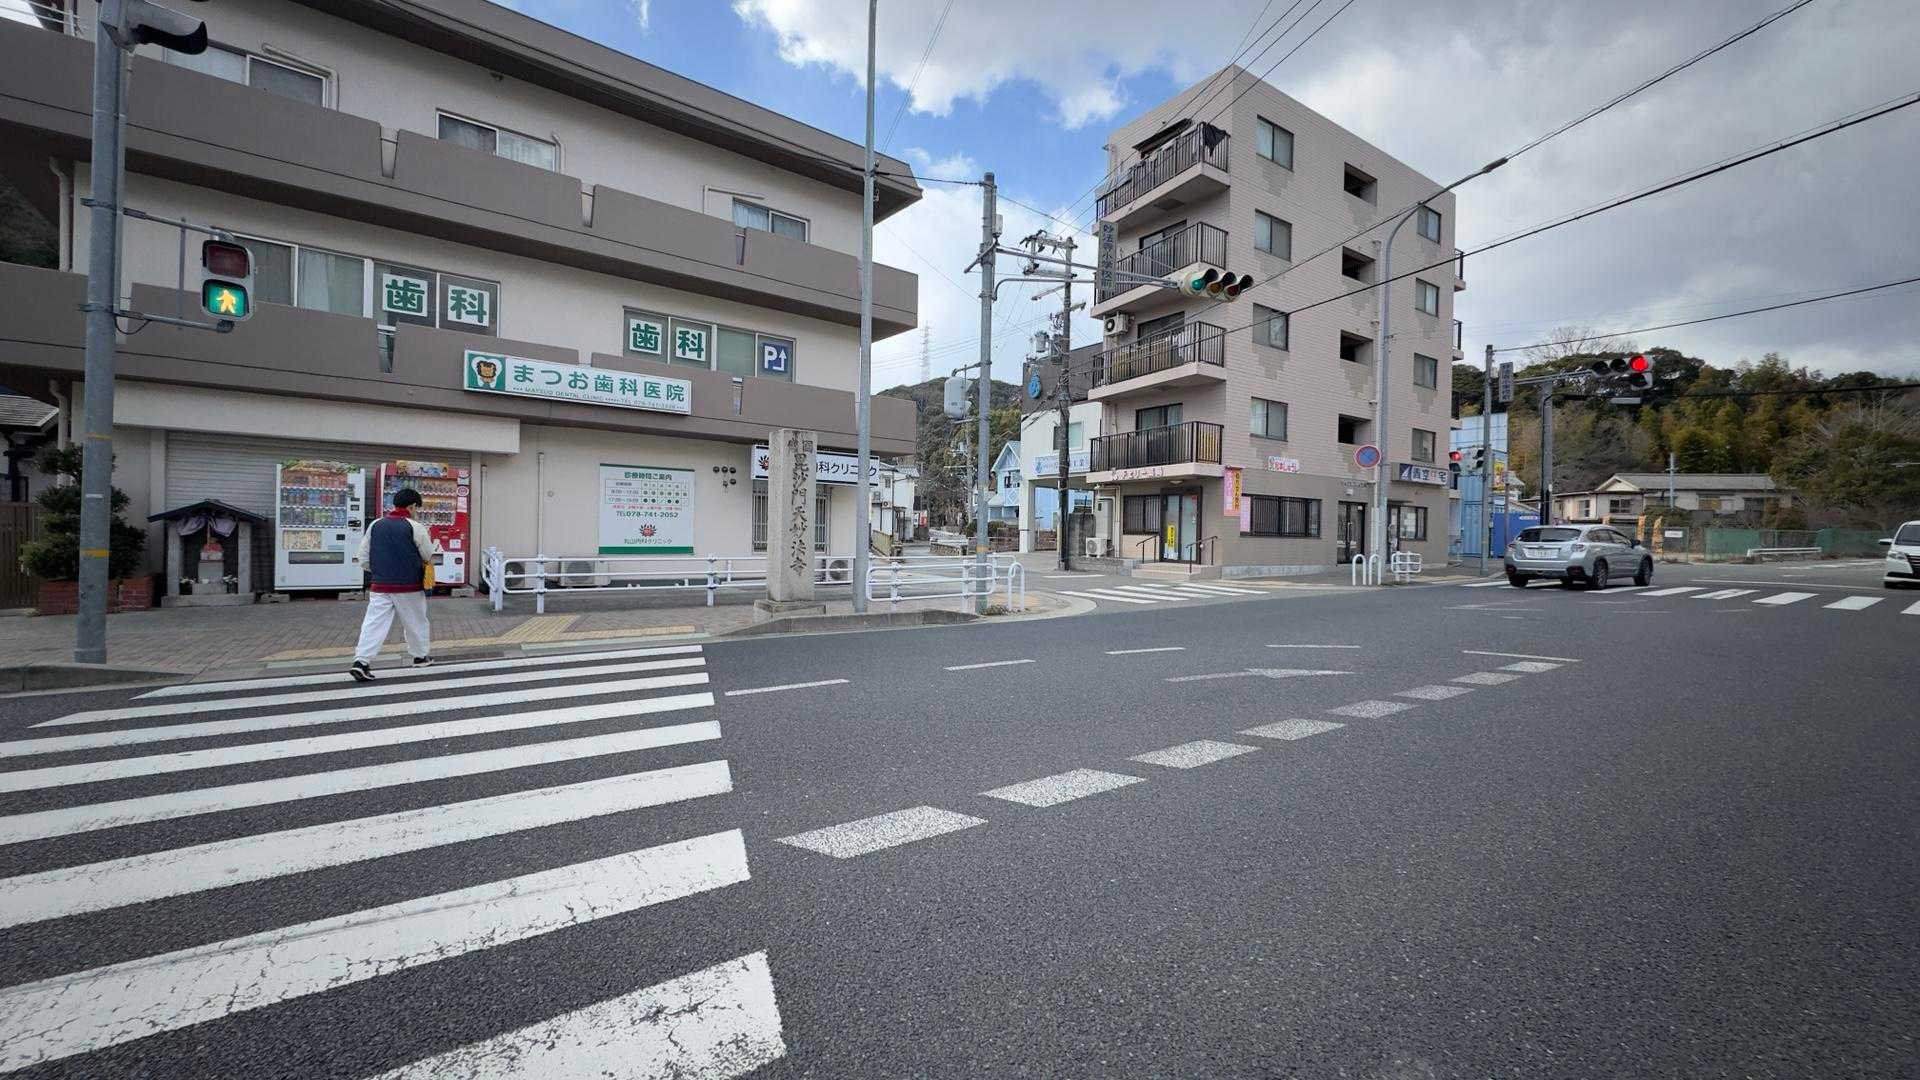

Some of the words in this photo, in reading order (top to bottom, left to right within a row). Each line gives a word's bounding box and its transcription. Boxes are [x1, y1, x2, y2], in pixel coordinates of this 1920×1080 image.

[763, 344, 779, 369] P
[513, 363, 686, 403] まつお歯科医院
[556, 390, 580, 400] DENTAL
